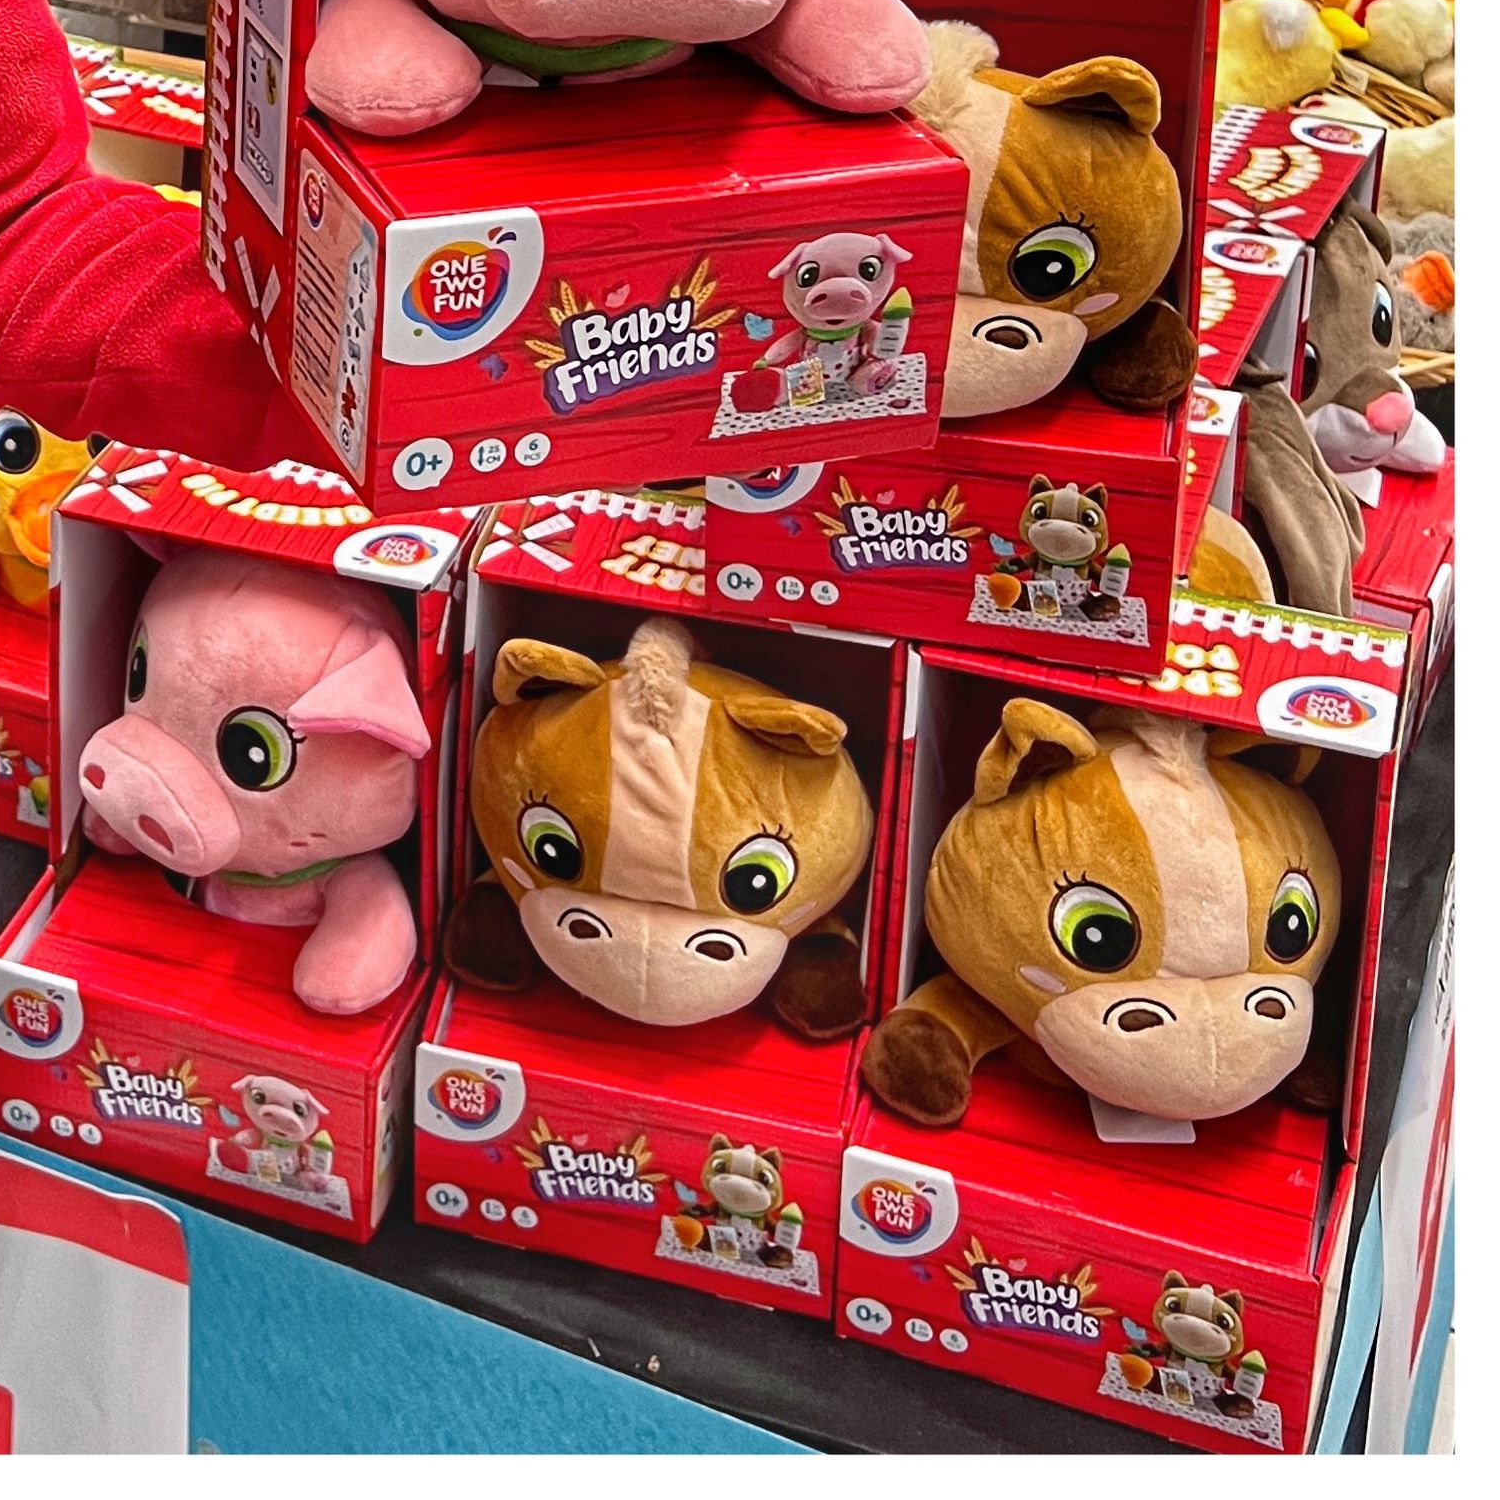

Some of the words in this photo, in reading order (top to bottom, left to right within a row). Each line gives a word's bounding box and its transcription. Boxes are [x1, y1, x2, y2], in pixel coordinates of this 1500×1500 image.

[430, 254, 487, 277] ONE
[429, 273, 486, 295] TWO
[434, 289, 485, 313] FUN
[572, 300, 692, 361] Baby
[555, 332, 716, 404] Friends
[528, 439, 538, 451] 6
[406, 451, 443, 477] 0+
[486, 454, 501, 464] CM
[523, 452, 541, 462] PCS
[227, 497, 372, 526] GREEDY
[851, 505, 946, 539] Baby
[621, 534, 706, 570] NEY
[838, 535, 968, 568] Friends
[600, 553, 706, 597] ORTY
[726, 571, 755, 591] 0+
[821, 585, 829, 595] 6
[1308, 693, 1352, 710] FUN
[1307, 709, 1354, 725] ONE
[13, 995, 49, 1013] ONE
[15, 1005, 49, 1023] TWO
[17, 1016, 49, 1034] FUN
[105, 1064, 183, 1100] Baby
[446, 1076, 485, 1094] ONE
[448, 1088, 485, 1104] TWO
[10, 1106, 33, 1122] 0+
[98, 1089, 203, 1125] Friends
[449, 1098, 485, 1116] FUN
[547, 1144, 635, 1178] Baby
[537, 1169, 655, 1203] Friends
[872, 1186, 915, 1207] ONE
[435, 1189, 461, 1207] 0+
[872, 1197, 915, 1219] TWO
[874, 1209, 913, 1230] FUN
[982, 1266, 1078, 1310] Baby
[855, 1304, 884, 1324] 0+
[968, 1292, 1100, 1338] Friends
